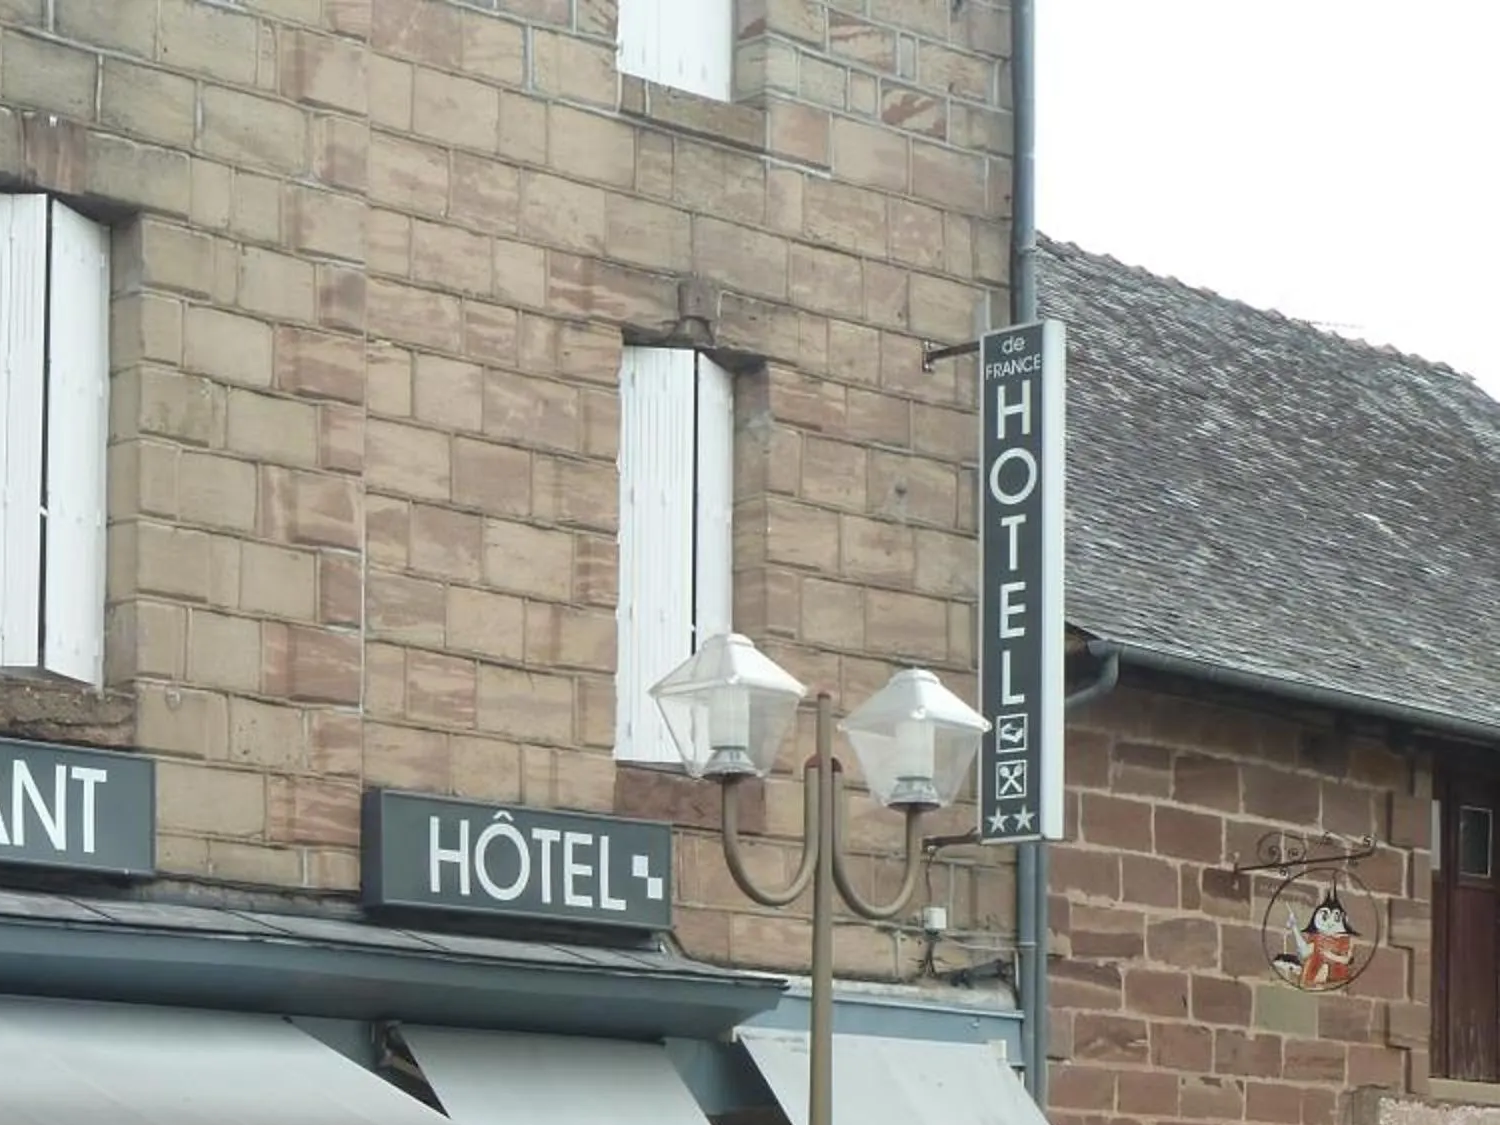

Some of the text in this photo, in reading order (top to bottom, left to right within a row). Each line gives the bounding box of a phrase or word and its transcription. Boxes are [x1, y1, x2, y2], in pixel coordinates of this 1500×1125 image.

[985, 353, 1041, 380] FRANCE
[1002, 335, 1025, 355] de
[989, 379, 1038, 705] HOTEL
[429, 810, 627, 911] HÔTEL
